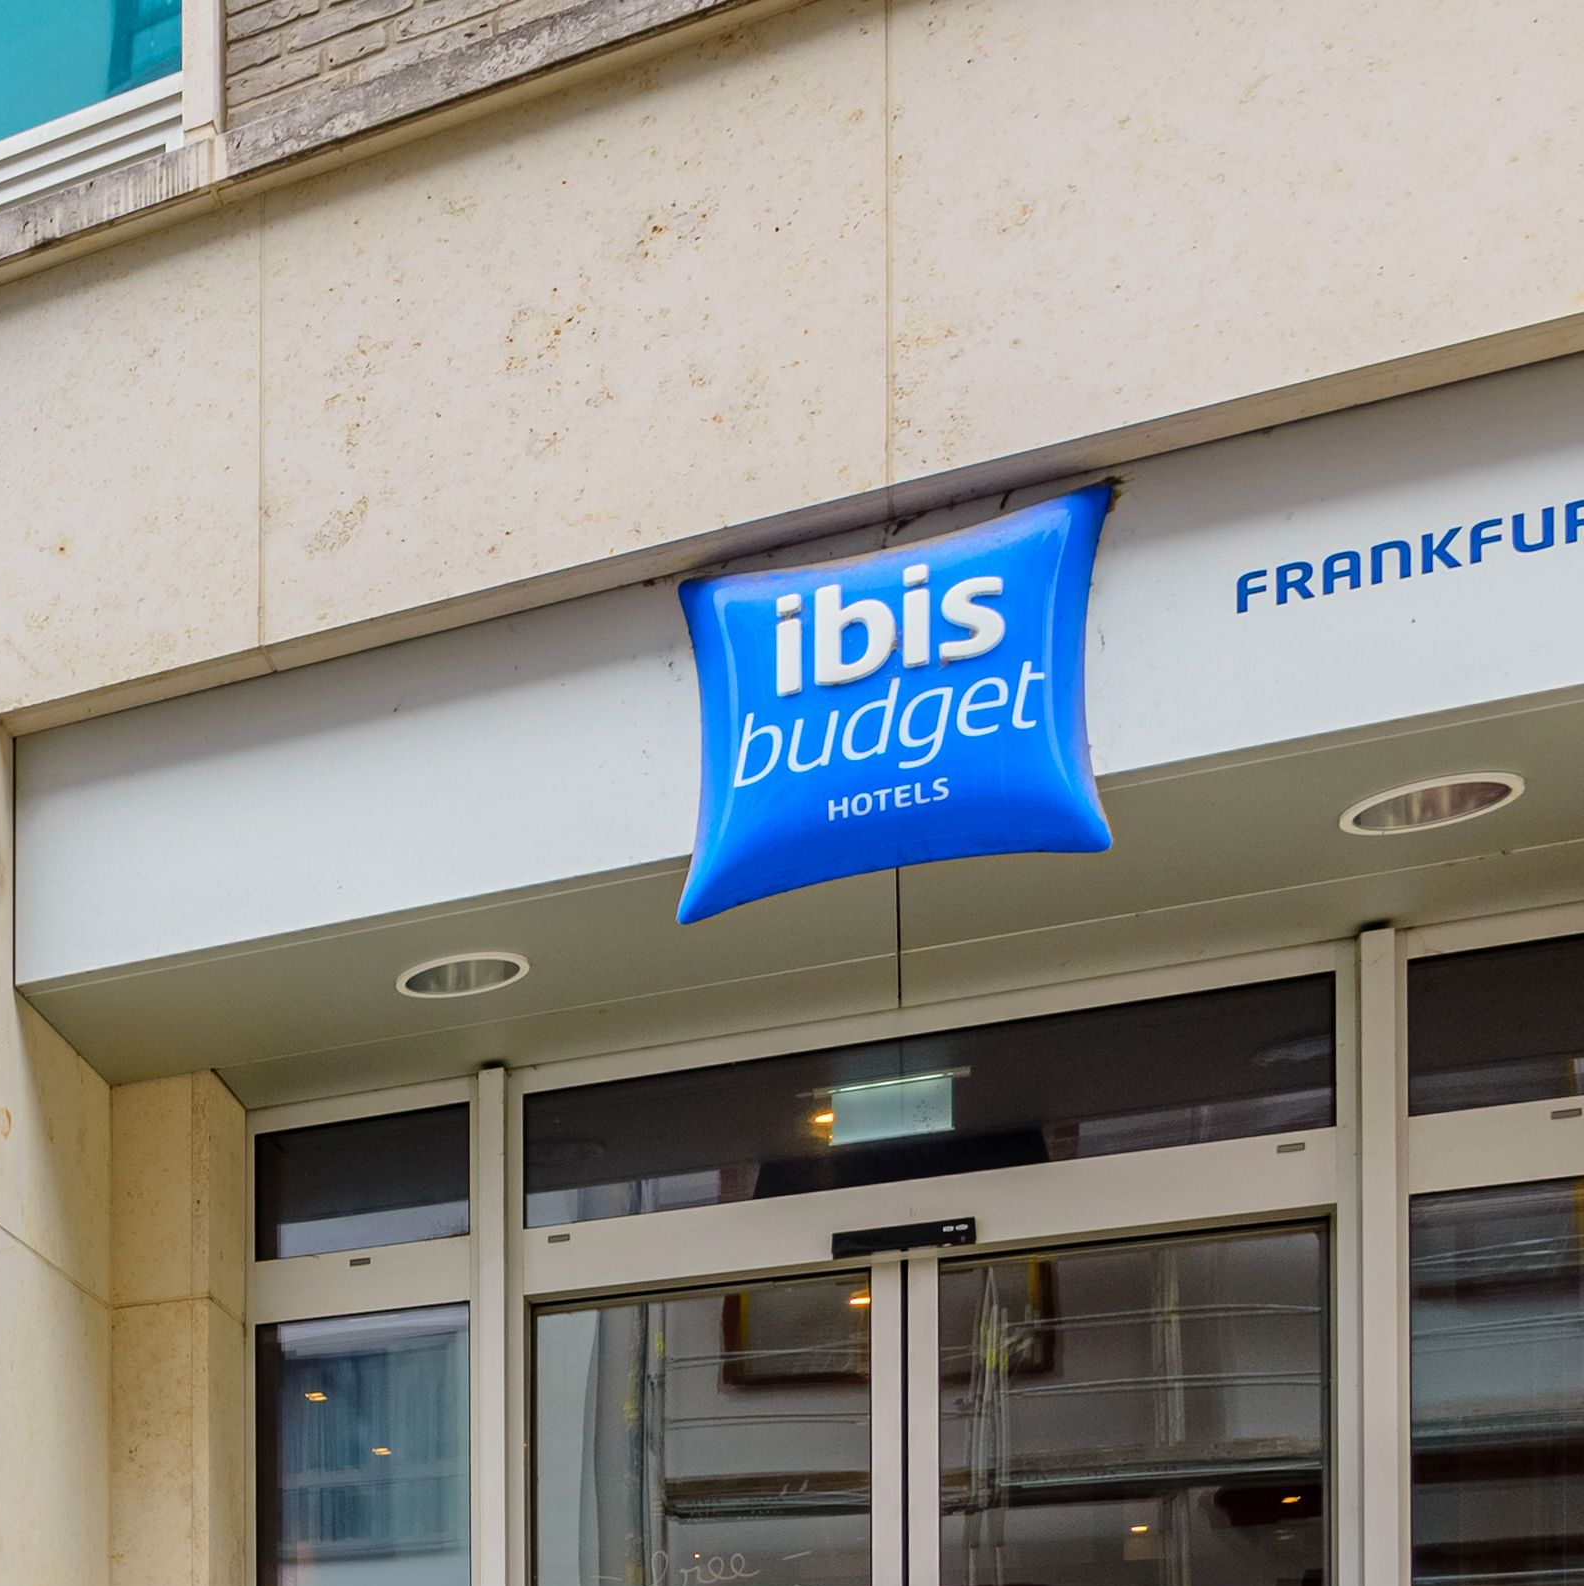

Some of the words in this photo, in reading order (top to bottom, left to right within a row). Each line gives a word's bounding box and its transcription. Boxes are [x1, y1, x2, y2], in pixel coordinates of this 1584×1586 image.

[776, 563, 1006, 697] ibis
[733, 660, 1045, 788] budget
[827, 777, 950, 821] HOTELS
